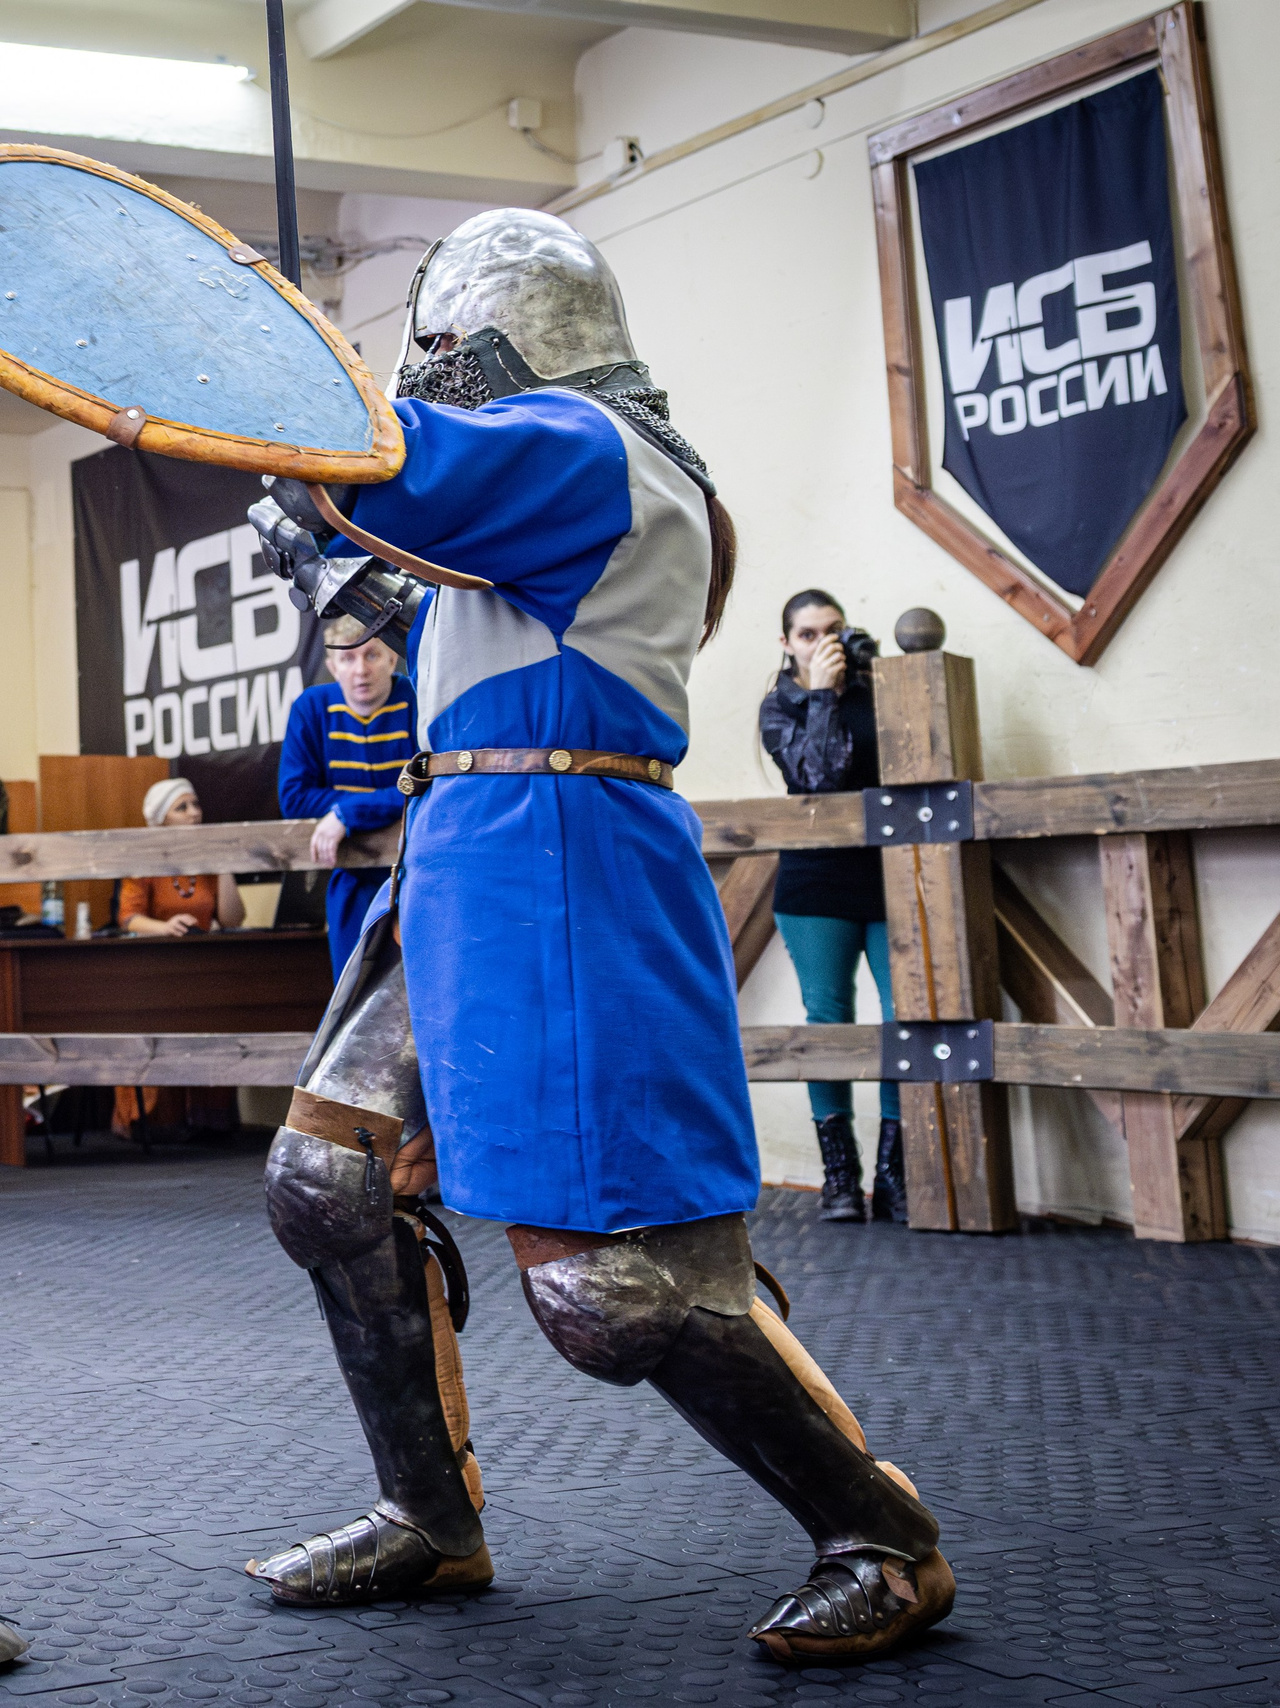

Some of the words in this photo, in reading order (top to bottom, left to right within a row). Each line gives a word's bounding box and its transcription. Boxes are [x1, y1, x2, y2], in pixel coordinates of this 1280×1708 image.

[944, 240, 1157, 394] ИСБ
[954, 344, 1168, 441] РОССИИ
[120, 523, 301, 696] ИСБ
[123, 666, 304, 758] РОССИИ
